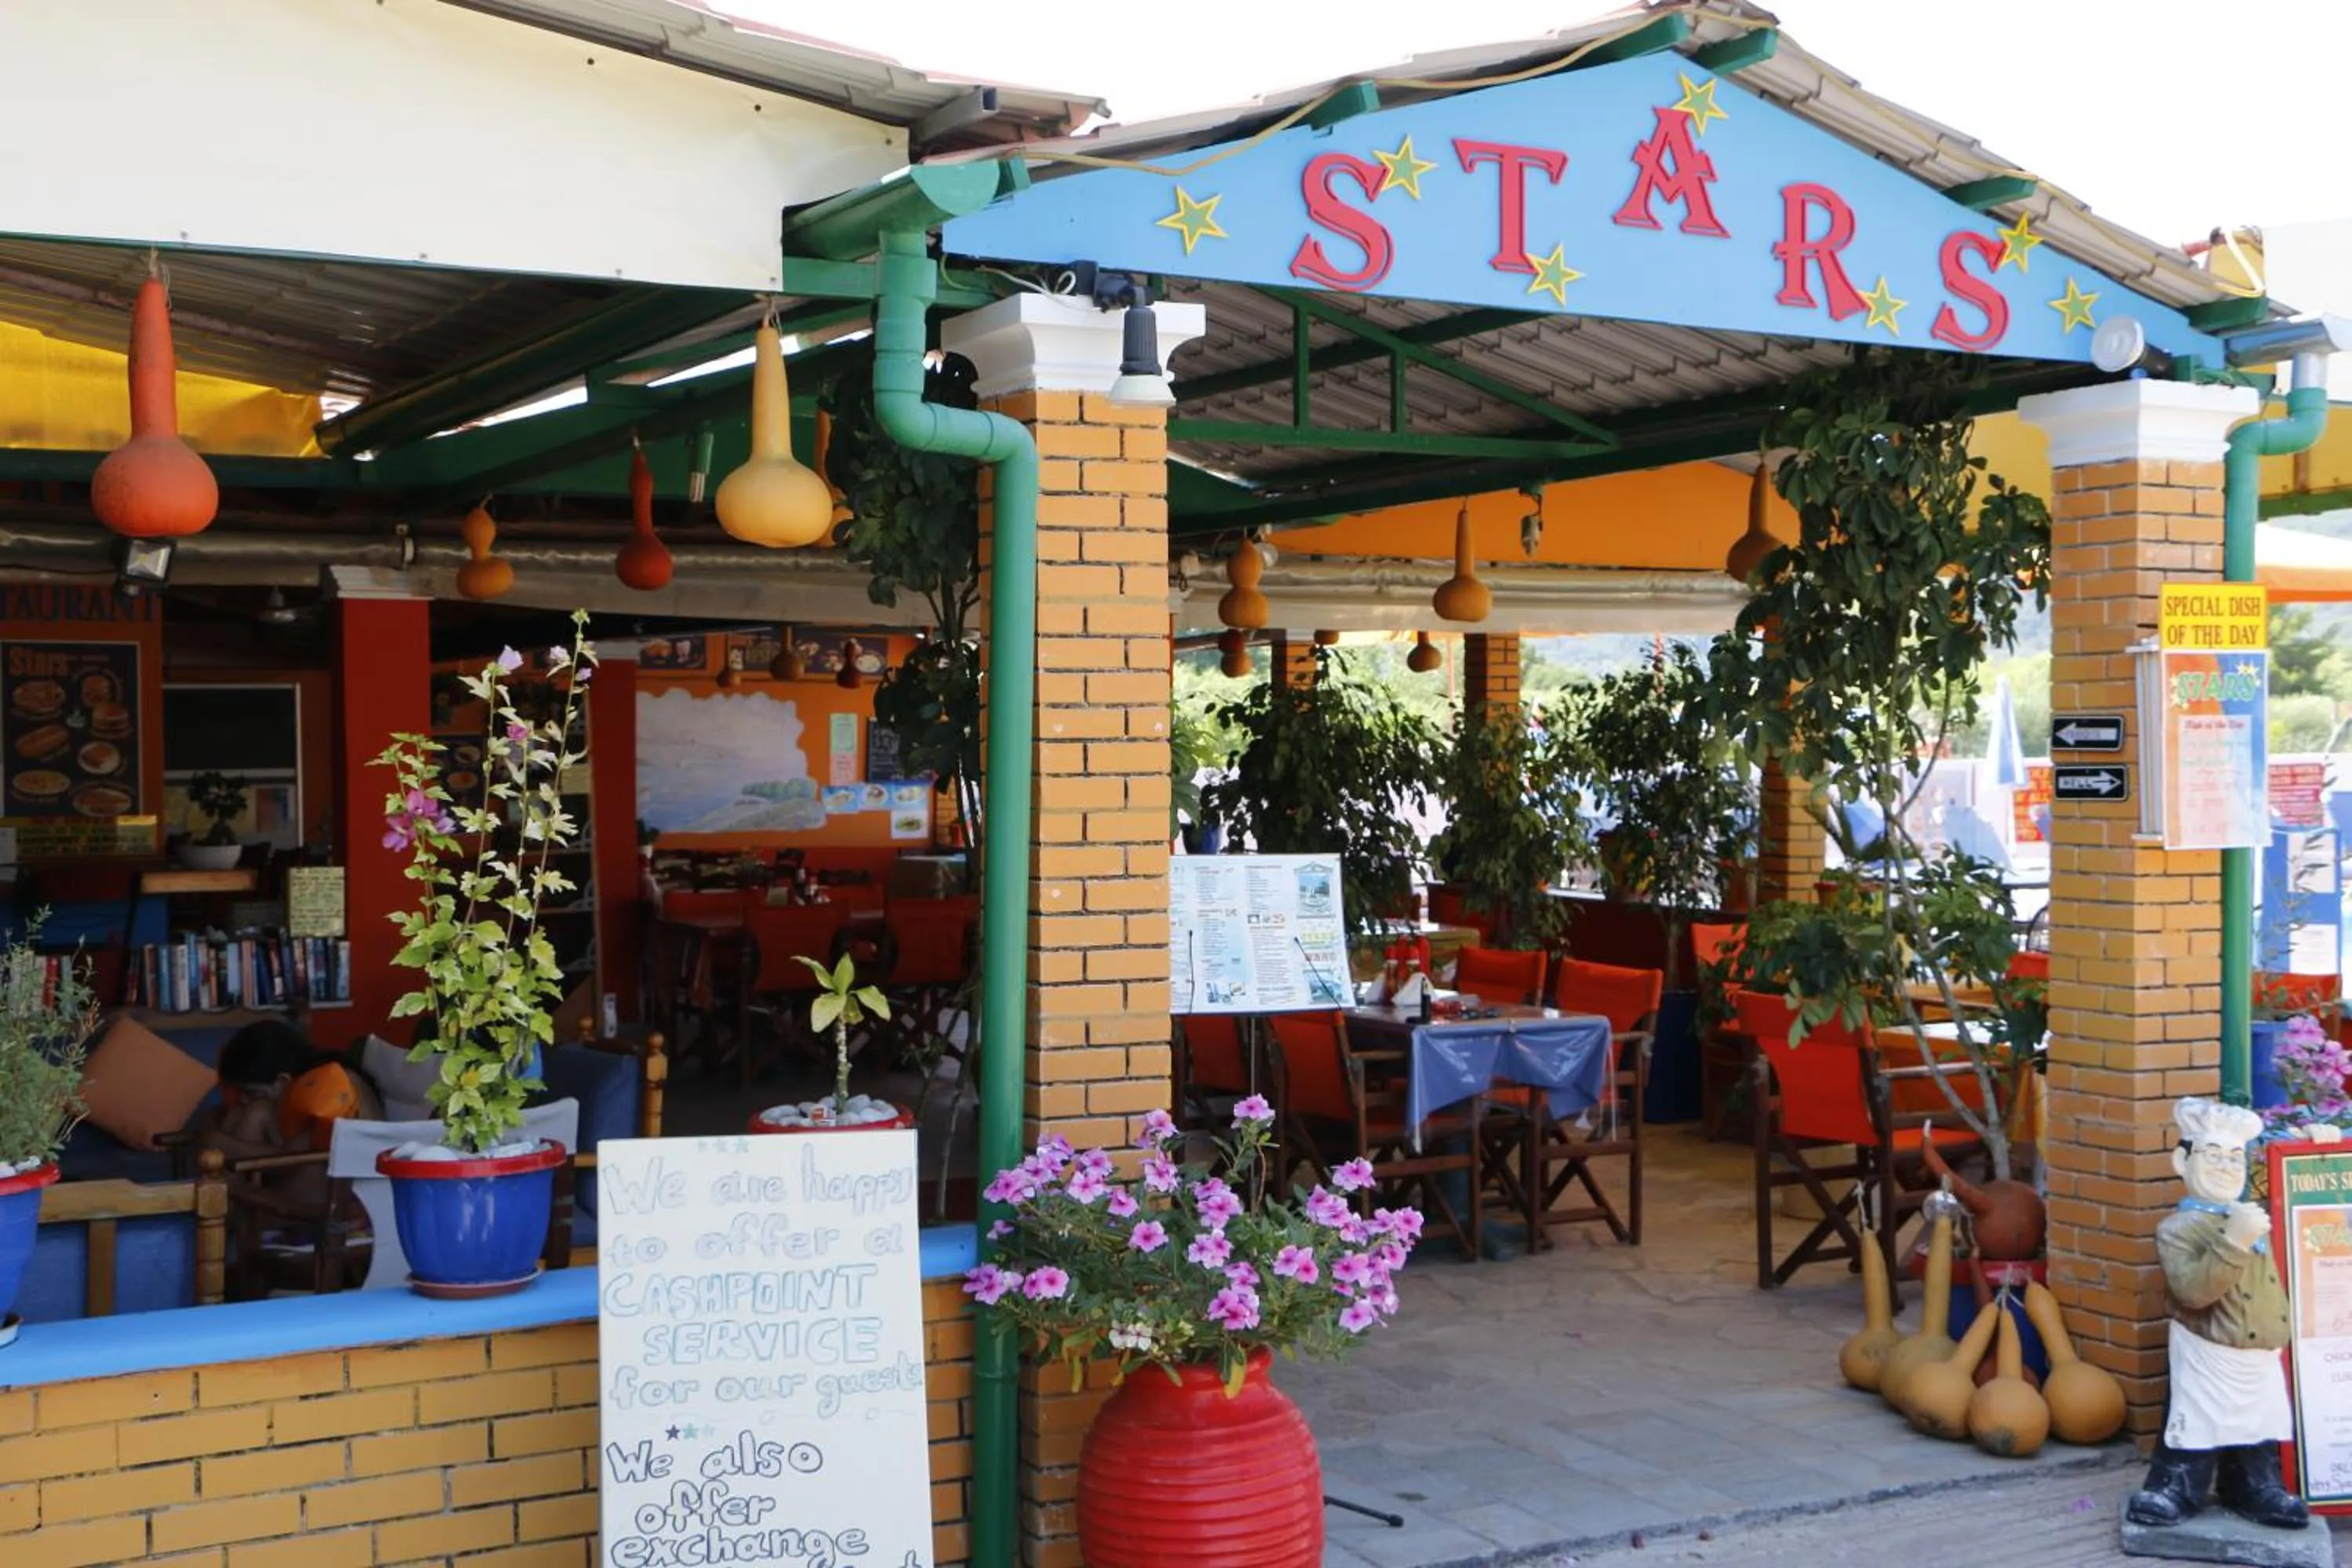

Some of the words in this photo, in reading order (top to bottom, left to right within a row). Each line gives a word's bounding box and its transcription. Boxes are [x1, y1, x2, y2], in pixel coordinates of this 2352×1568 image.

[1290, 106, 2009, 352] STARS
[2165, 596, 2224, 617] SPECIAL
[2229, 596, 2261, 617] DISH
[2167, 624, 2187, 645] OF
[2190, 624, 2223, 648] THE
[2229, 625, 2260, 645] DAY
[2176, 671, 2256, 702] STARS
[603, 1156, 688, 1214] We
[712, 1171, 786, 1203] are
[800, 1143, 913, 1215] happy
[2290, 1173, 2337, 1192] TODAY'S
[608, 1234, 668, 1268] to
[695, 1212, 840, 1260] offer
[864, 1222, 903, 1254] a
[603, 1264, 878, 1319] CASHPOINT
[644, 1317, 883, 1365] SERVICE
[609, 1366, 699, 1410] for
[715, 1374, 807, 1403] our
[816, 1351, 923, 1417] guests
[607, 1439, 673, 1483] We
[700, 1430, 824, 1481] also
[635, 1479, 776, 1534] offer
[611, 1525, 870, 1568] exchange
